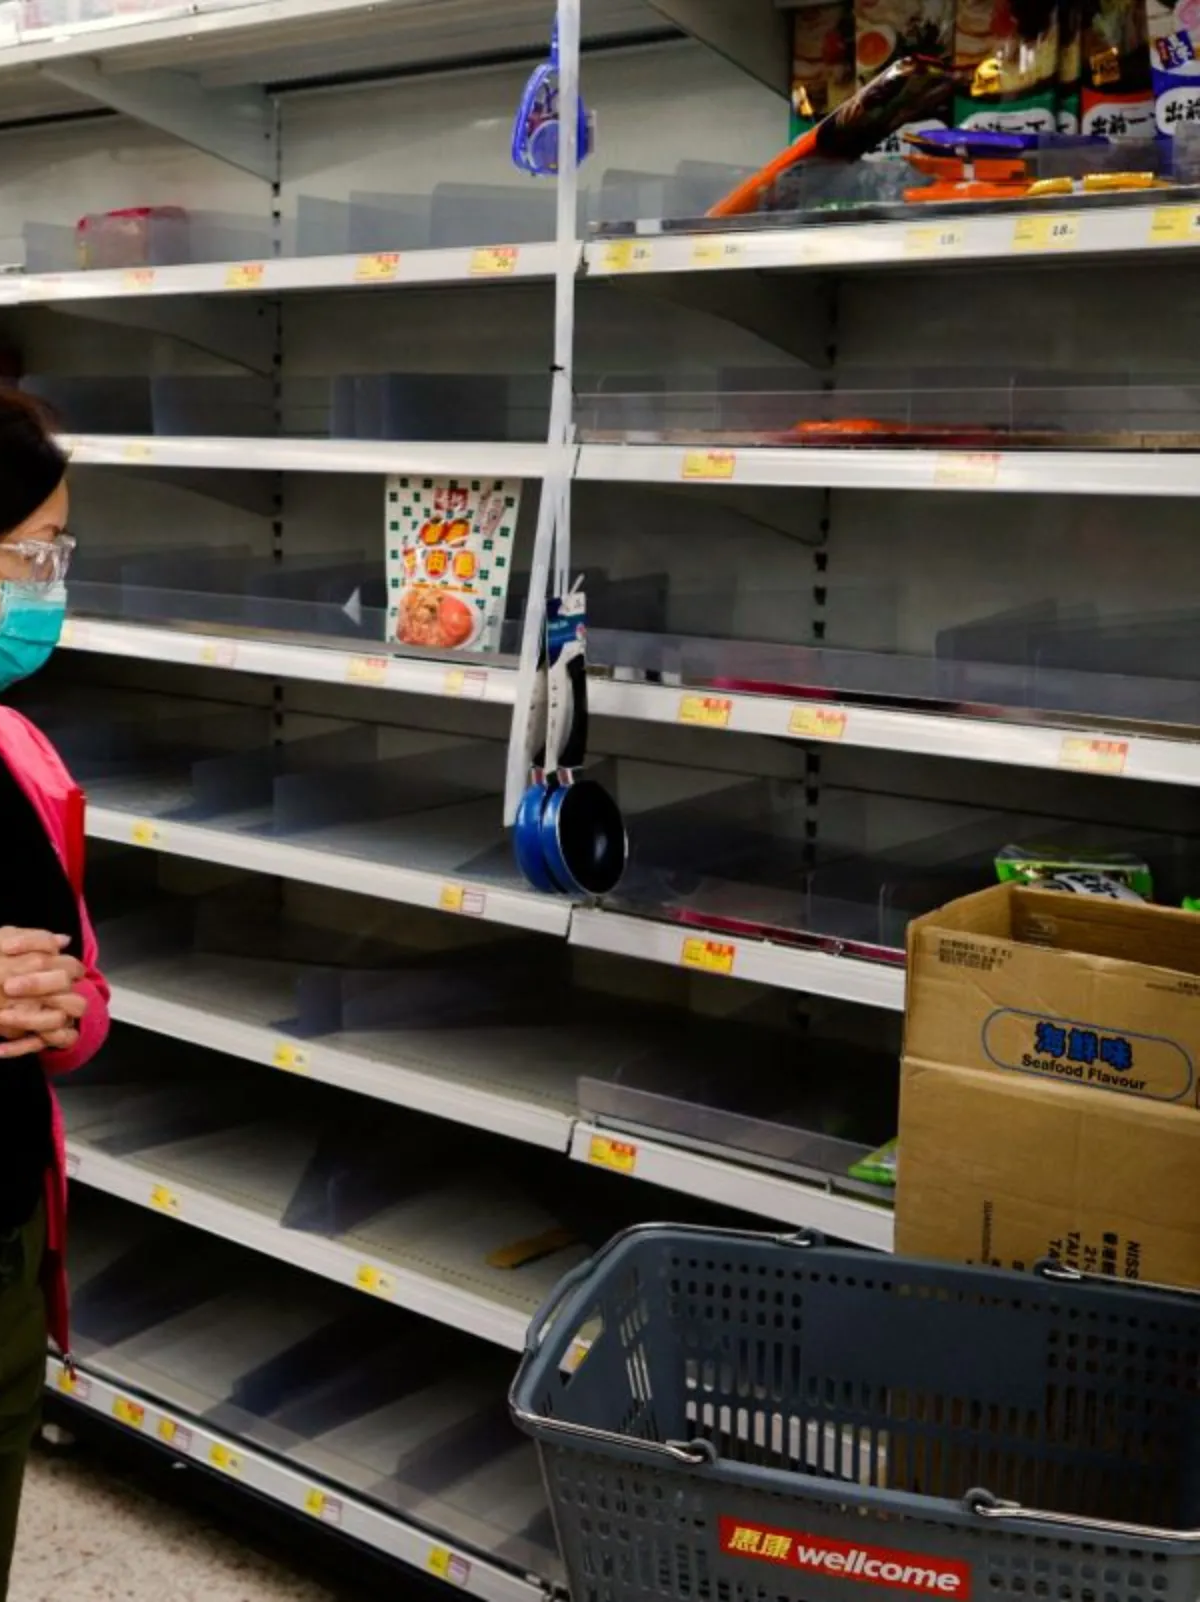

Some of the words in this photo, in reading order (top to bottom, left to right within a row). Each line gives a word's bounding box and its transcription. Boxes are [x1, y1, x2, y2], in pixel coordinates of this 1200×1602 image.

[1034, 1022, 1133, 1071] 海鮮味
[1021, 1053, 1084, 1080] Seafood
[1087, 1067, 1146, 1091] Flavour
[728, 1526, 792, 1558] 惠康
[797, 1545, 960, 1591] wellcome
